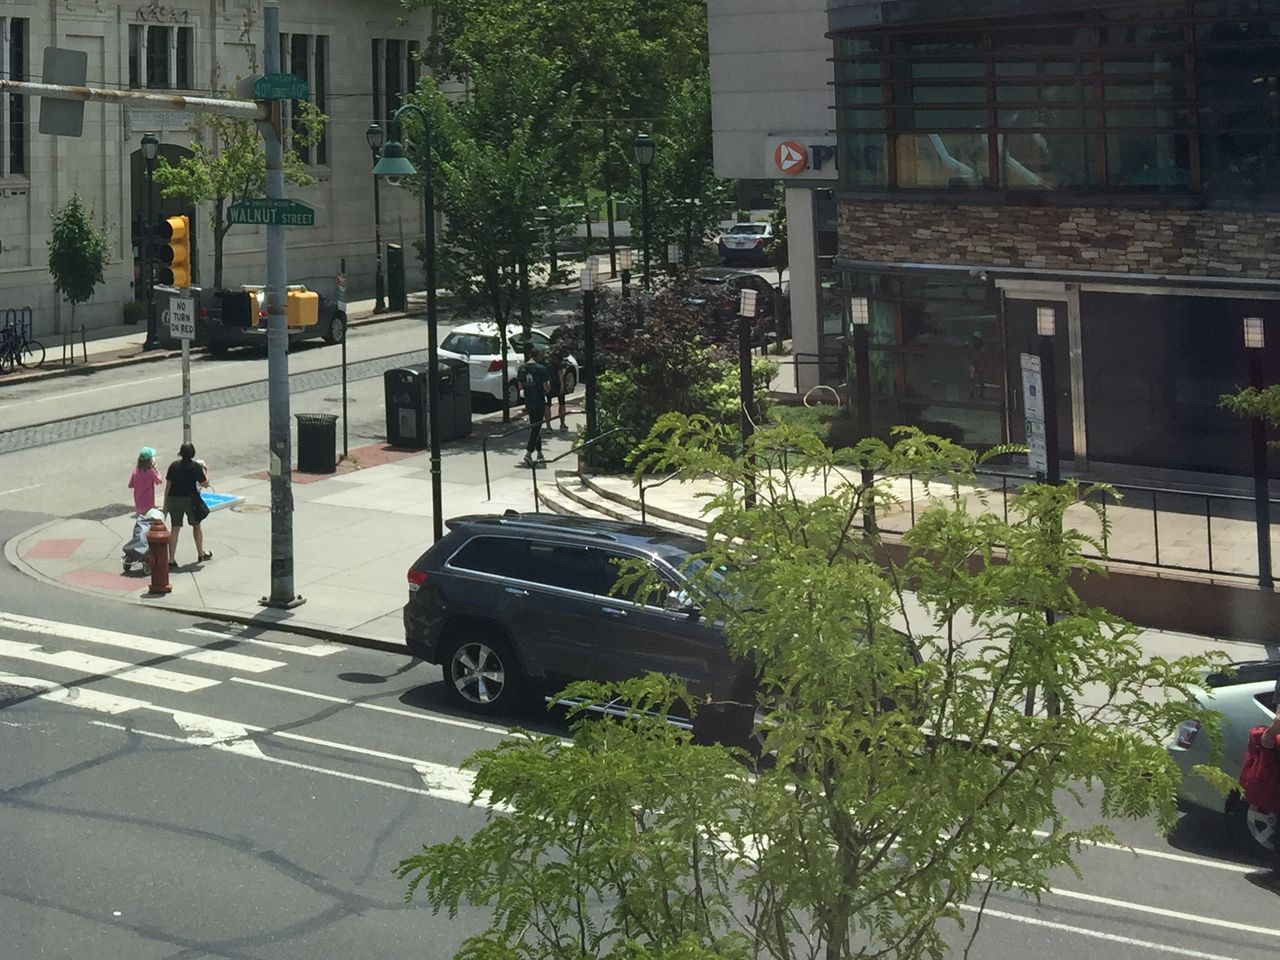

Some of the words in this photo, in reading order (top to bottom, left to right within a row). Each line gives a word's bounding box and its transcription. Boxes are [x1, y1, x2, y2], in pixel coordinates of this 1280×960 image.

[230, 207, 277, 223] WALNUT
[281, 213, 312, 224] STREET
[176, 301, 186, 310] NO
[173, 312, 190, 321] TURN
[171, 323, 180, 332] ON
[180, 324, 193, 333] RED
